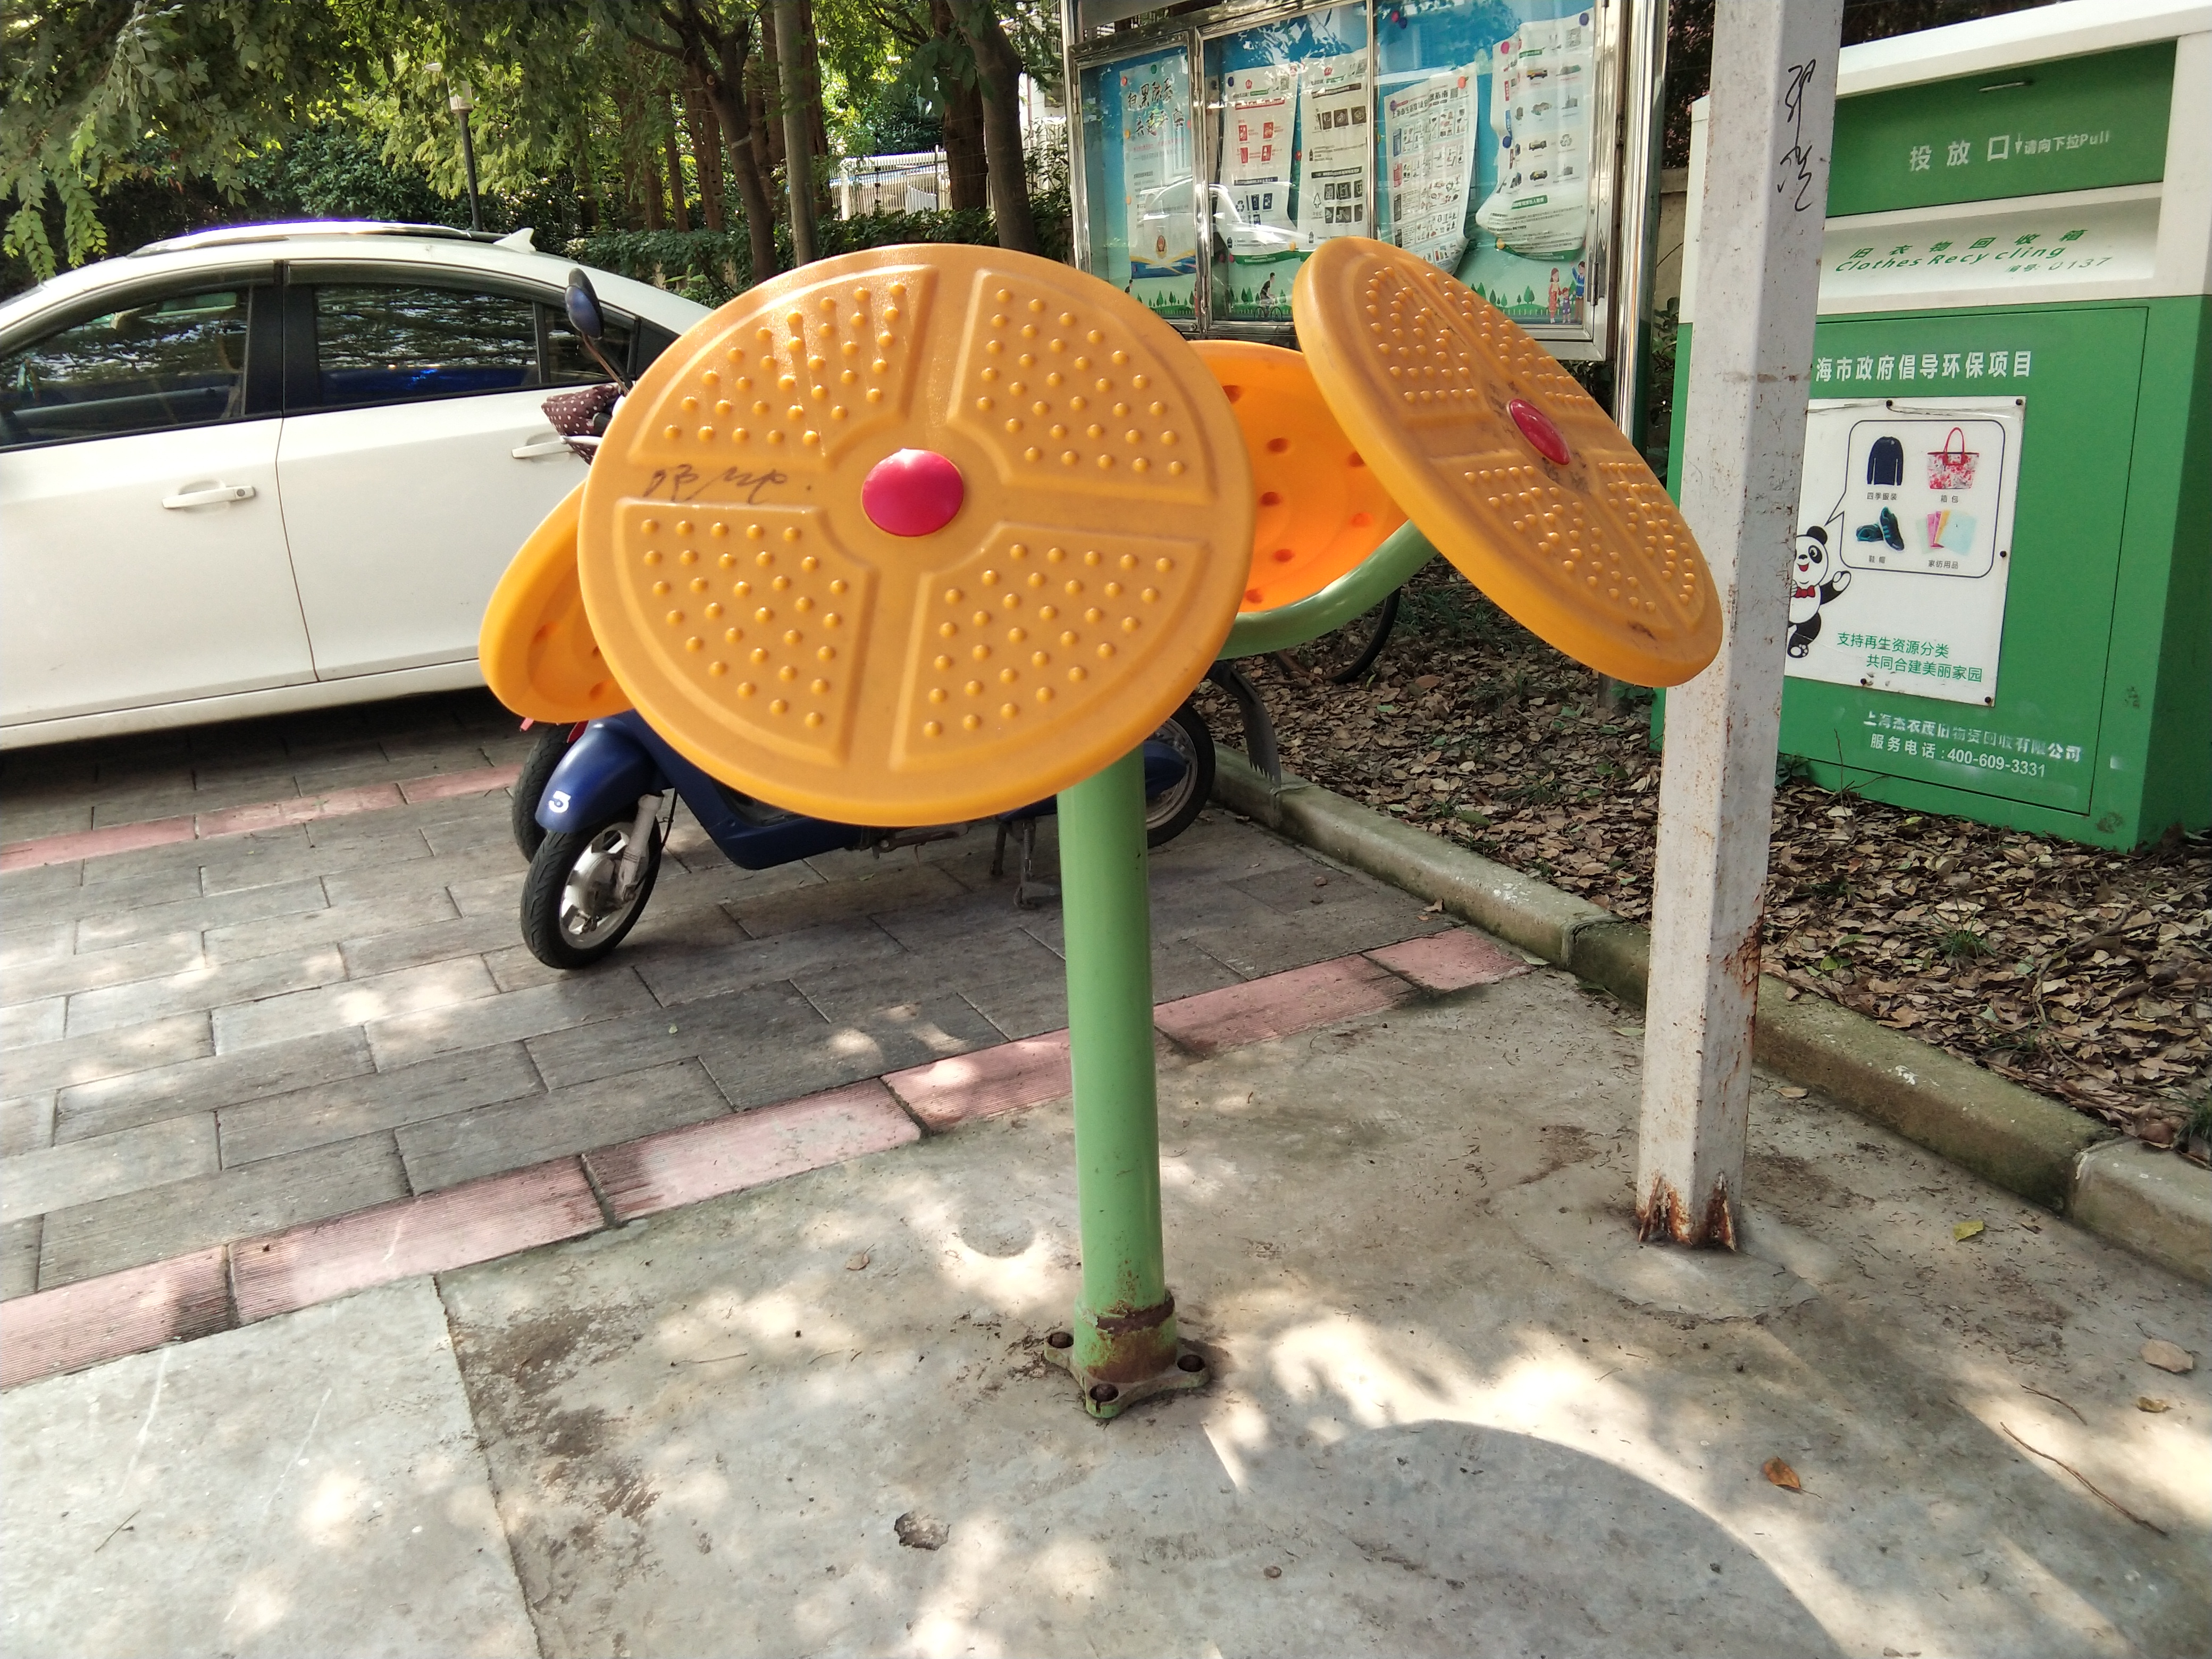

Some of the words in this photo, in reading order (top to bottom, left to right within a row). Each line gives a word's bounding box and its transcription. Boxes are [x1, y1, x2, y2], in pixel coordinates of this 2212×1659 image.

[1909, 135, 2010, 171] 投放口
[1849, 229, 2088, 259] 旧衣物回收箱
[1836, 253, 1920, 272] Clothes
[2049, 257, 2113, 271] 0137
[1815, 351, 2031, 382] 海市政府倡导环保项目
[1941, 495, 1959, 503] 箱包
[1869, 555, 1886, 564] 鞋帽
[1928, 560, 1959, 569] 家纺用品
[1837, 632, 1949, 658] 支持再生资源分类
[1866, 653, 1982, 682] 共同合建美丽家园
